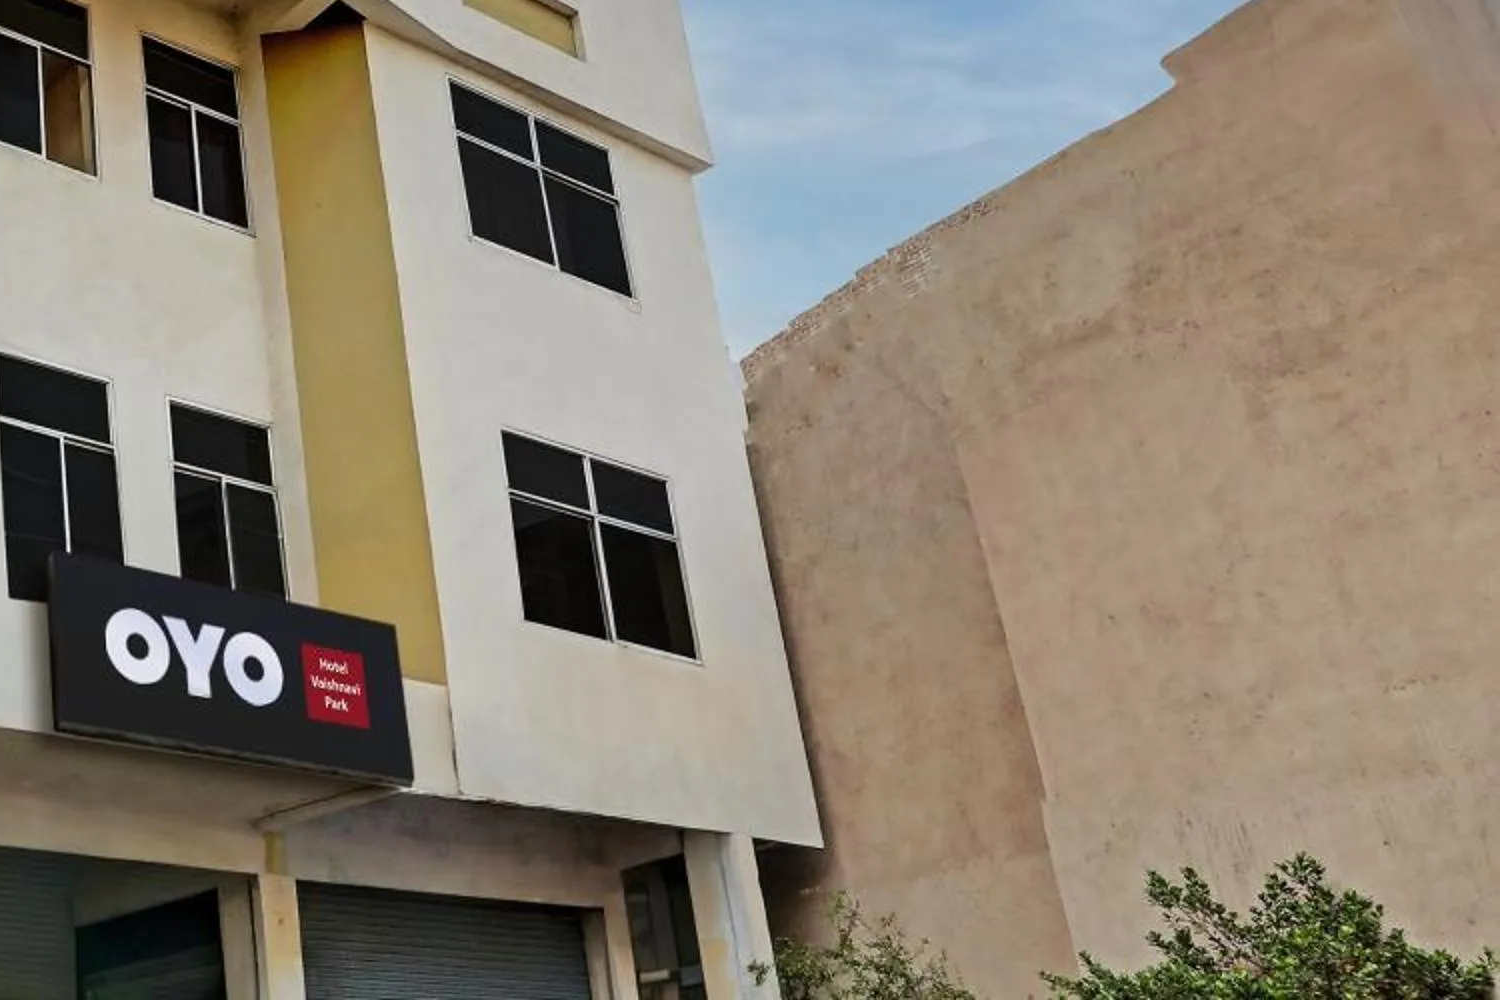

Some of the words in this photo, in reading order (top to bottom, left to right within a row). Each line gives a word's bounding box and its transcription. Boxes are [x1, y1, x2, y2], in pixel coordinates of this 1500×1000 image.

[105, 607, 284, 707] OYO
[319, 657, 349, 675] Hotel
[310, 675, 361, 696] Vaishnavi
[324, 695, 349, 712] Park
